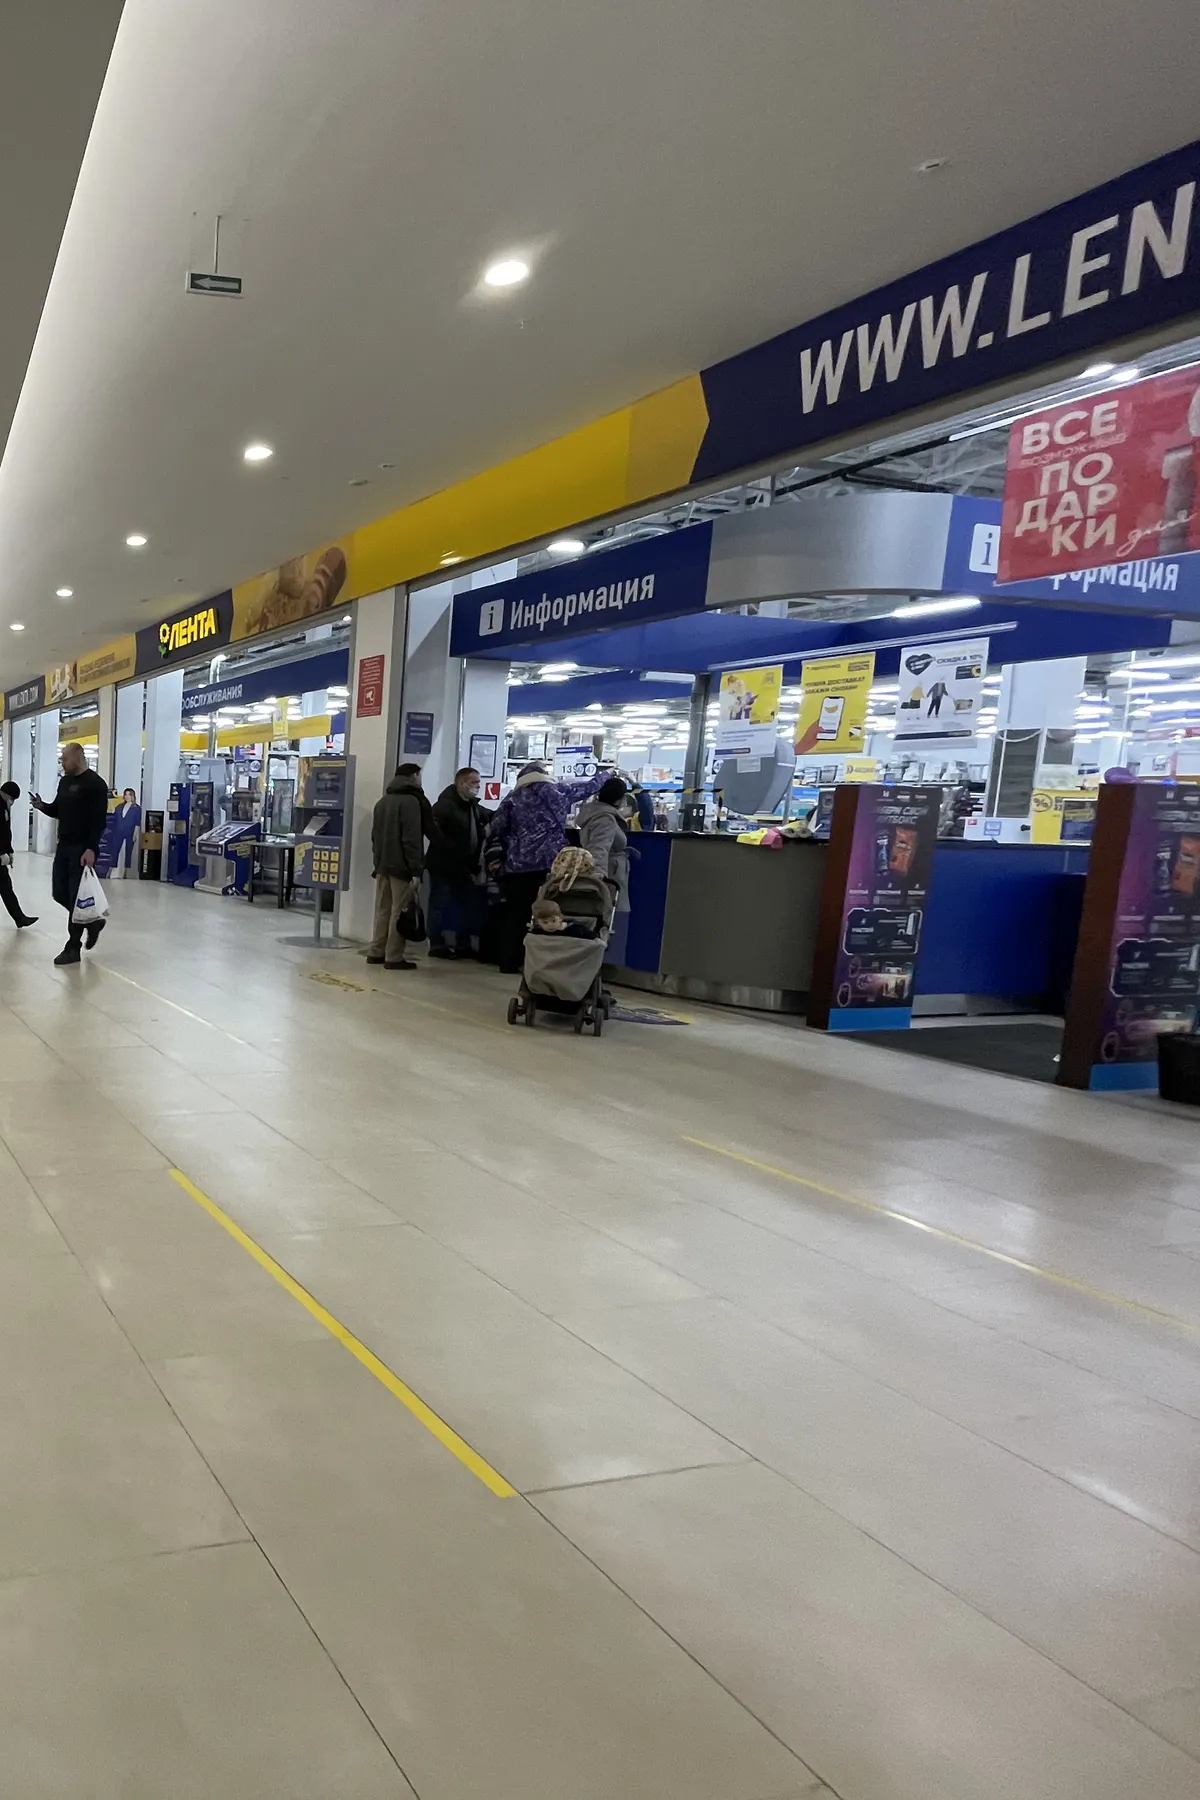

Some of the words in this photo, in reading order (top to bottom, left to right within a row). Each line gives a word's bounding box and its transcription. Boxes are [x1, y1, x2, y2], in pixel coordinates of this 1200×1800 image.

[800, 181, 1196, 414] WWW.LEN
[1019, 400, 1119, 454] ВСЕ
[1039, 452, 1114, 496] ПО
[1014, 483, 1118, 537] ДАР
[1051, 514, 1117, 556] КИ
[169, 608, 216, 650] ЛЕНТА
[510, 574, 655, 631] Информация
